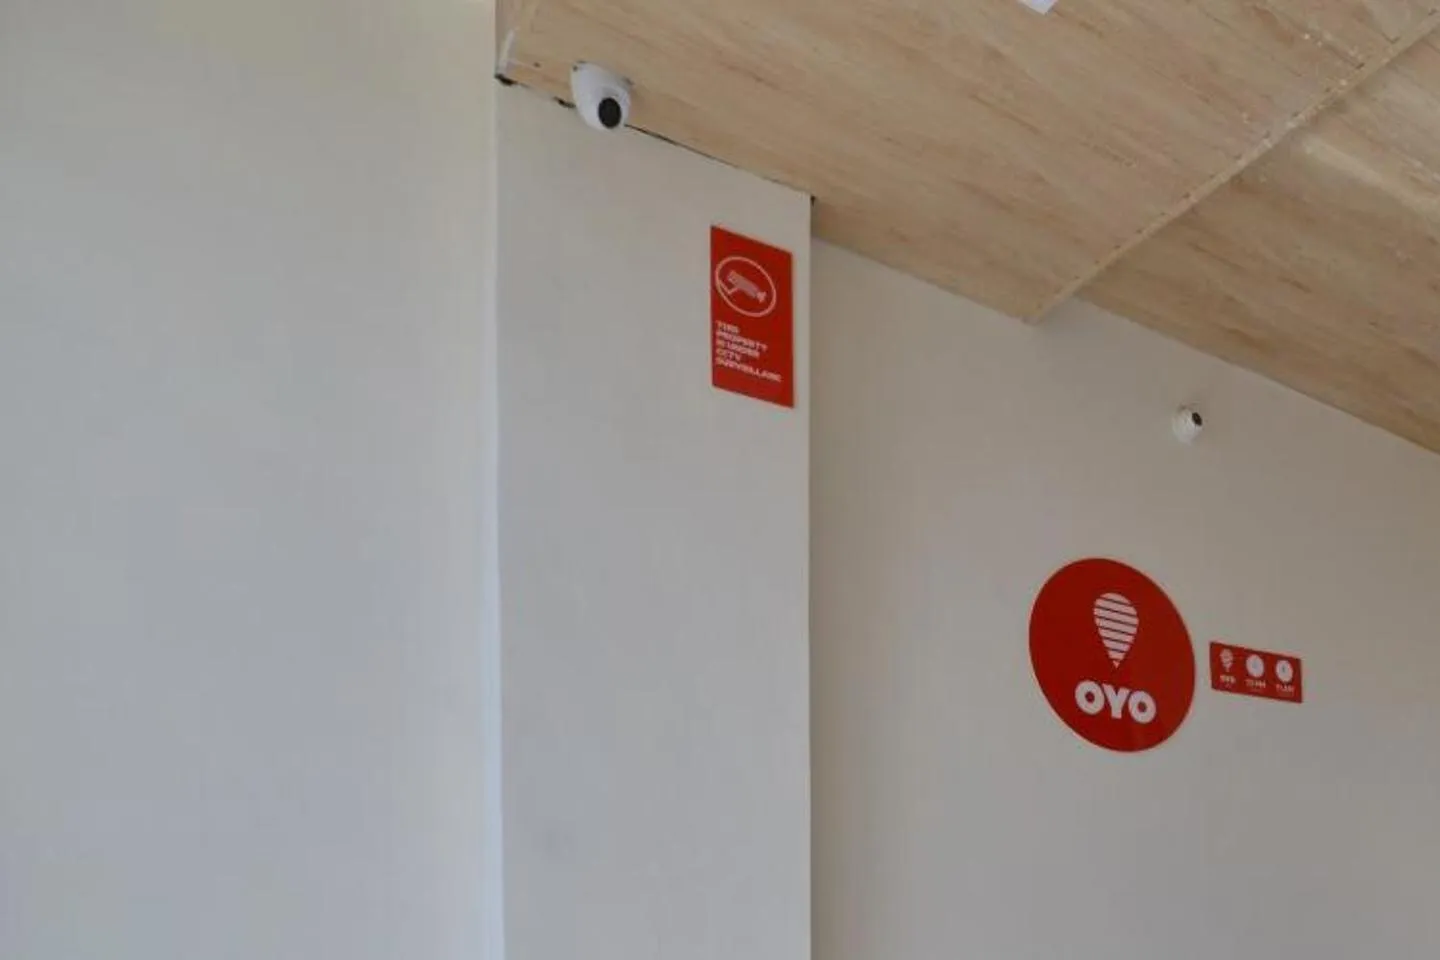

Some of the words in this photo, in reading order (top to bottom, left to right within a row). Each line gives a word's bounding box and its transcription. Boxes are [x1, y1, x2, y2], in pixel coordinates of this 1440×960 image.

[715, 331, 768, 352] PROPERTY
[727, 341, 760, 358] UNDER
[1074, 679, 1157, 724] OYO
